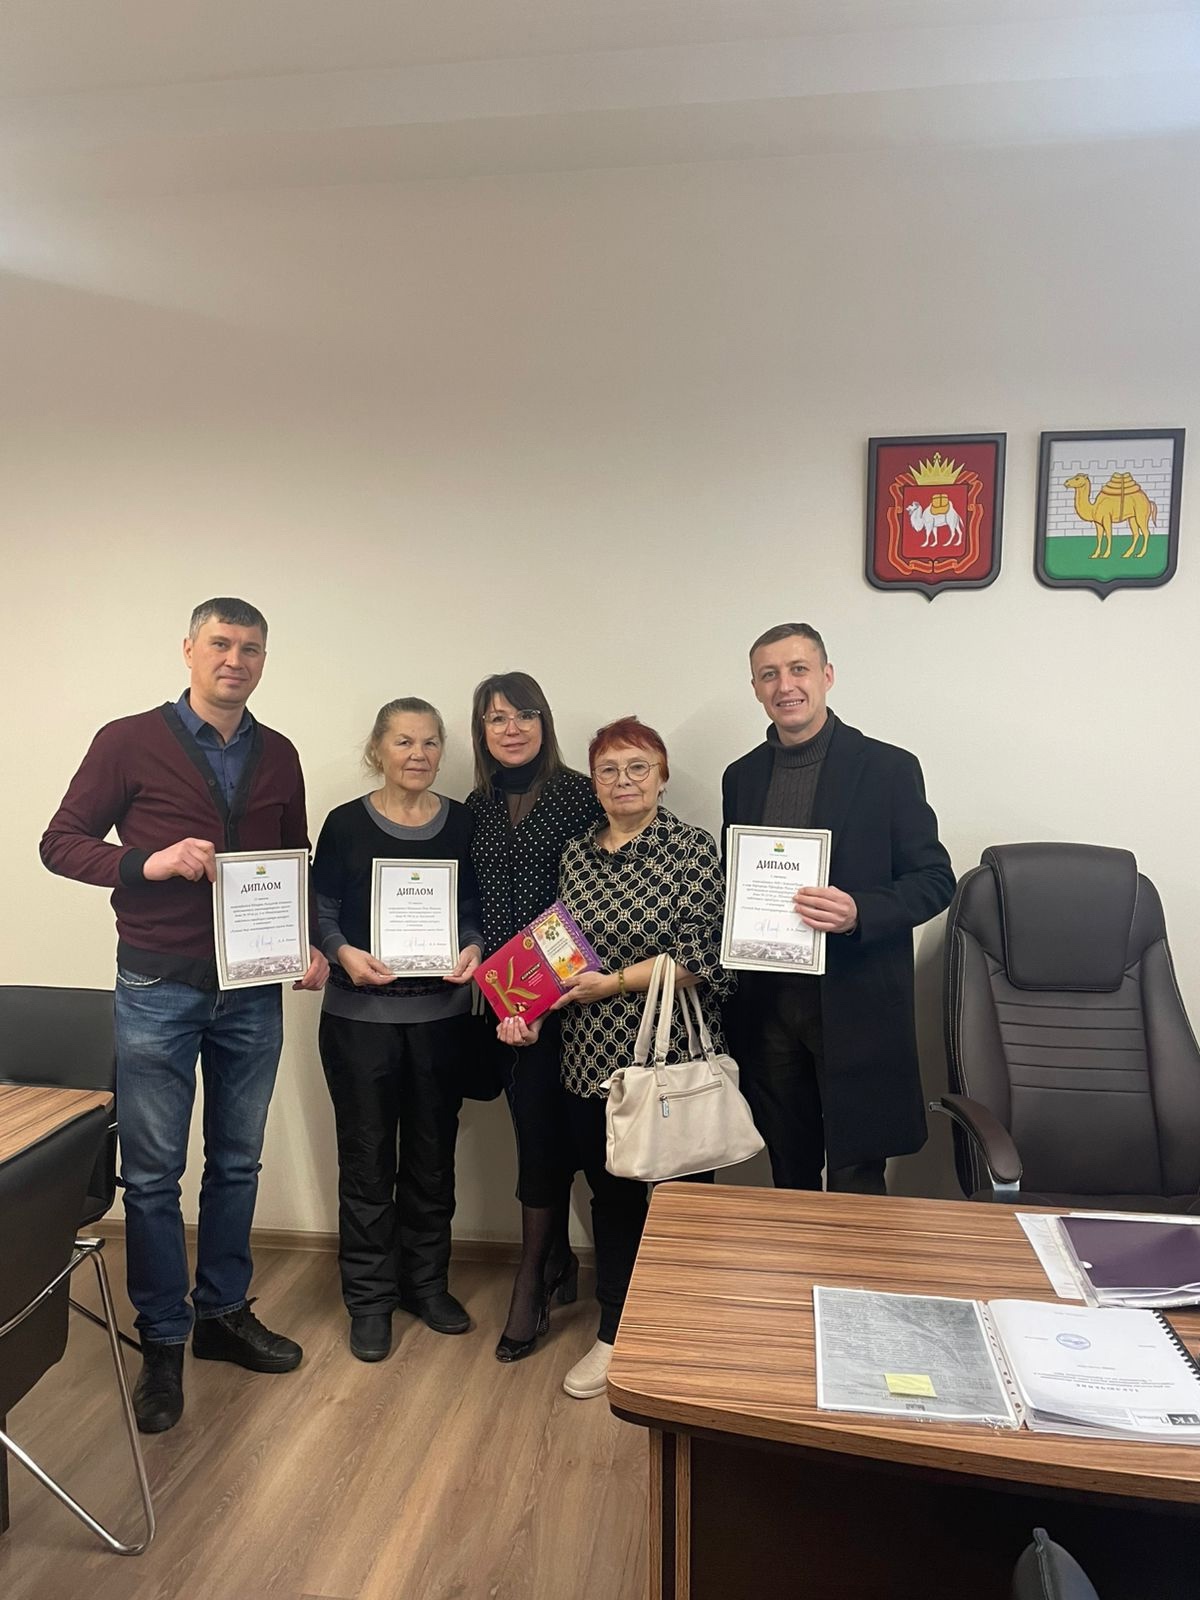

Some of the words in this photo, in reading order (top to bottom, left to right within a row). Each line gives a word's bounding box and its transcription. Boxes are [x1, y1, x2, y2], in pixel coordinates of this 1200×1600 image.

[755, 860, 801, 872] ДИПЛОМ
[240, 882, 282, 895] ДИПЛОМ
[396, 887, 434, 897] ДИПЛОМ
